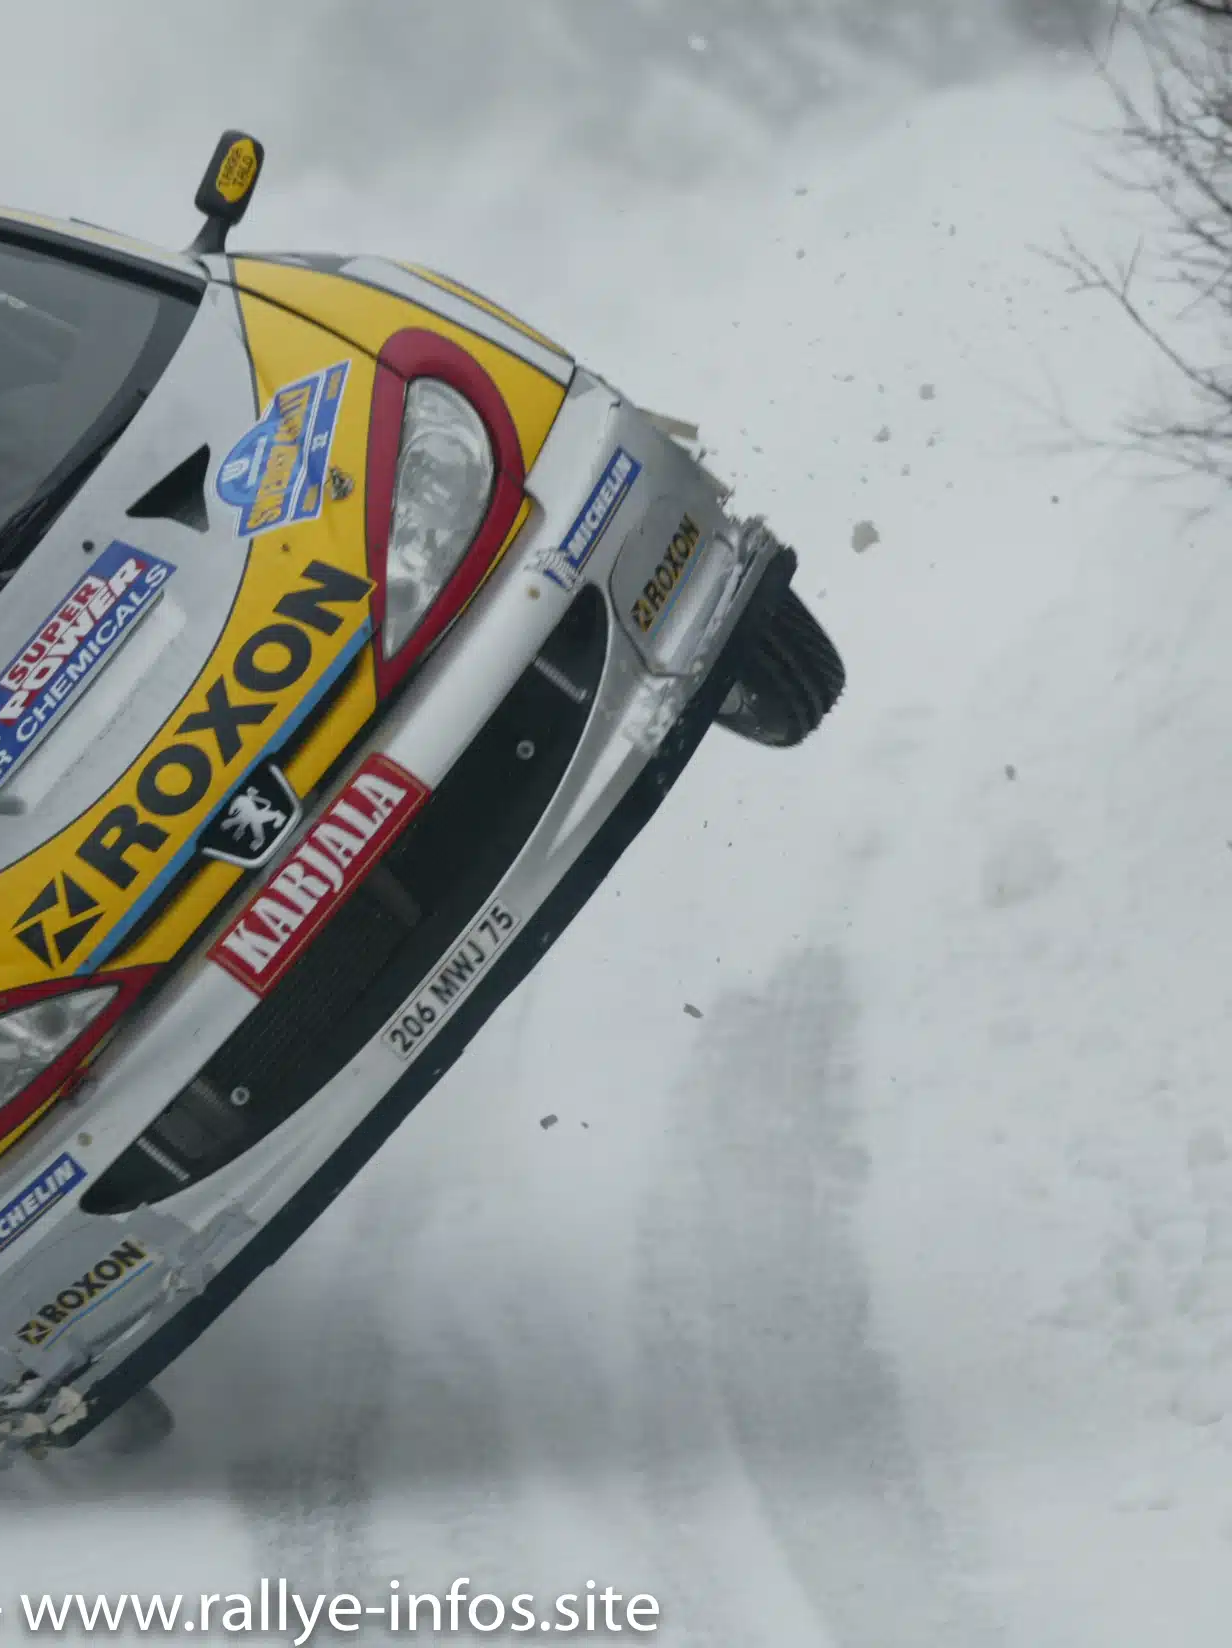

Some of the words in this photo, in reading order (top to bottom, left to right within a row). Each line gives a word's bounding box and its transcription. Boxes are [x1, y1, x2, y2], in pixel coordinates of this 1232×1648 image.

[567, 452, 634, 561] MICHELIN
[642, 512, 700, 613] ROXON
[7, 583, 99, 682] SUPER
[16, 563, 168, 742] CHEMICALS
[76, 560, 375, 890] ROXON
[222, 773, 406, 974] KARJALA
[390, 1002, 435, 1052] 206
[429, 940, 485, 1005] MWJ
[479, 906, 513, 945] 75
[37, 1240, 147, 1323] ROXON
